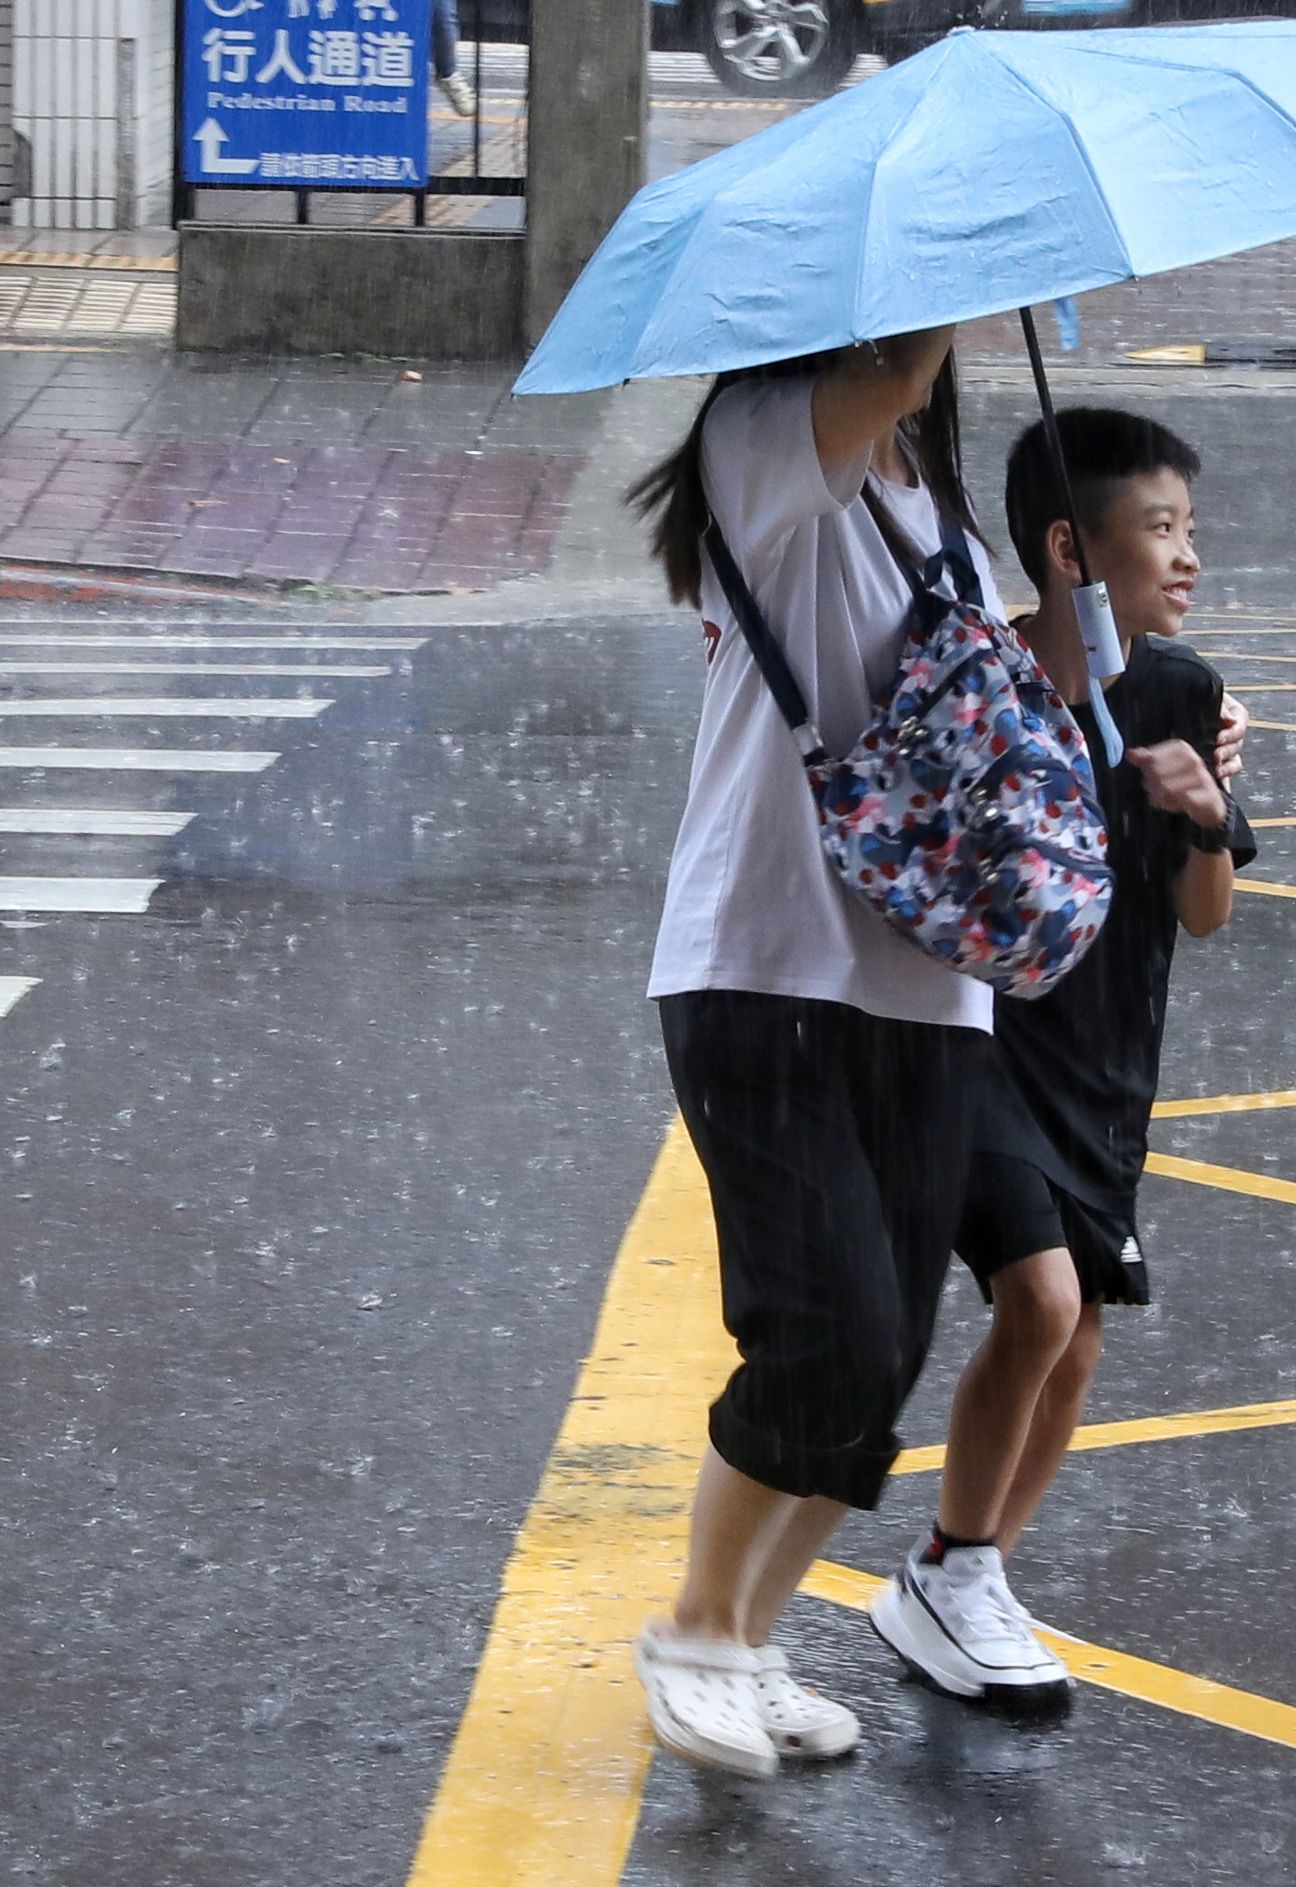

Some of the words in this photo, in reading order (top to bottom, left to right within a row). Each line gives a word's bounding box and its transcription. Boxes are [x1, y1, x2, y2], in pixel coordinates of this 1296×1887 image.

[201, 28, 415, 87] 行人通道
[207, 91, 336, 111] Pedestrian
[343, 95, 408, 113] Road
